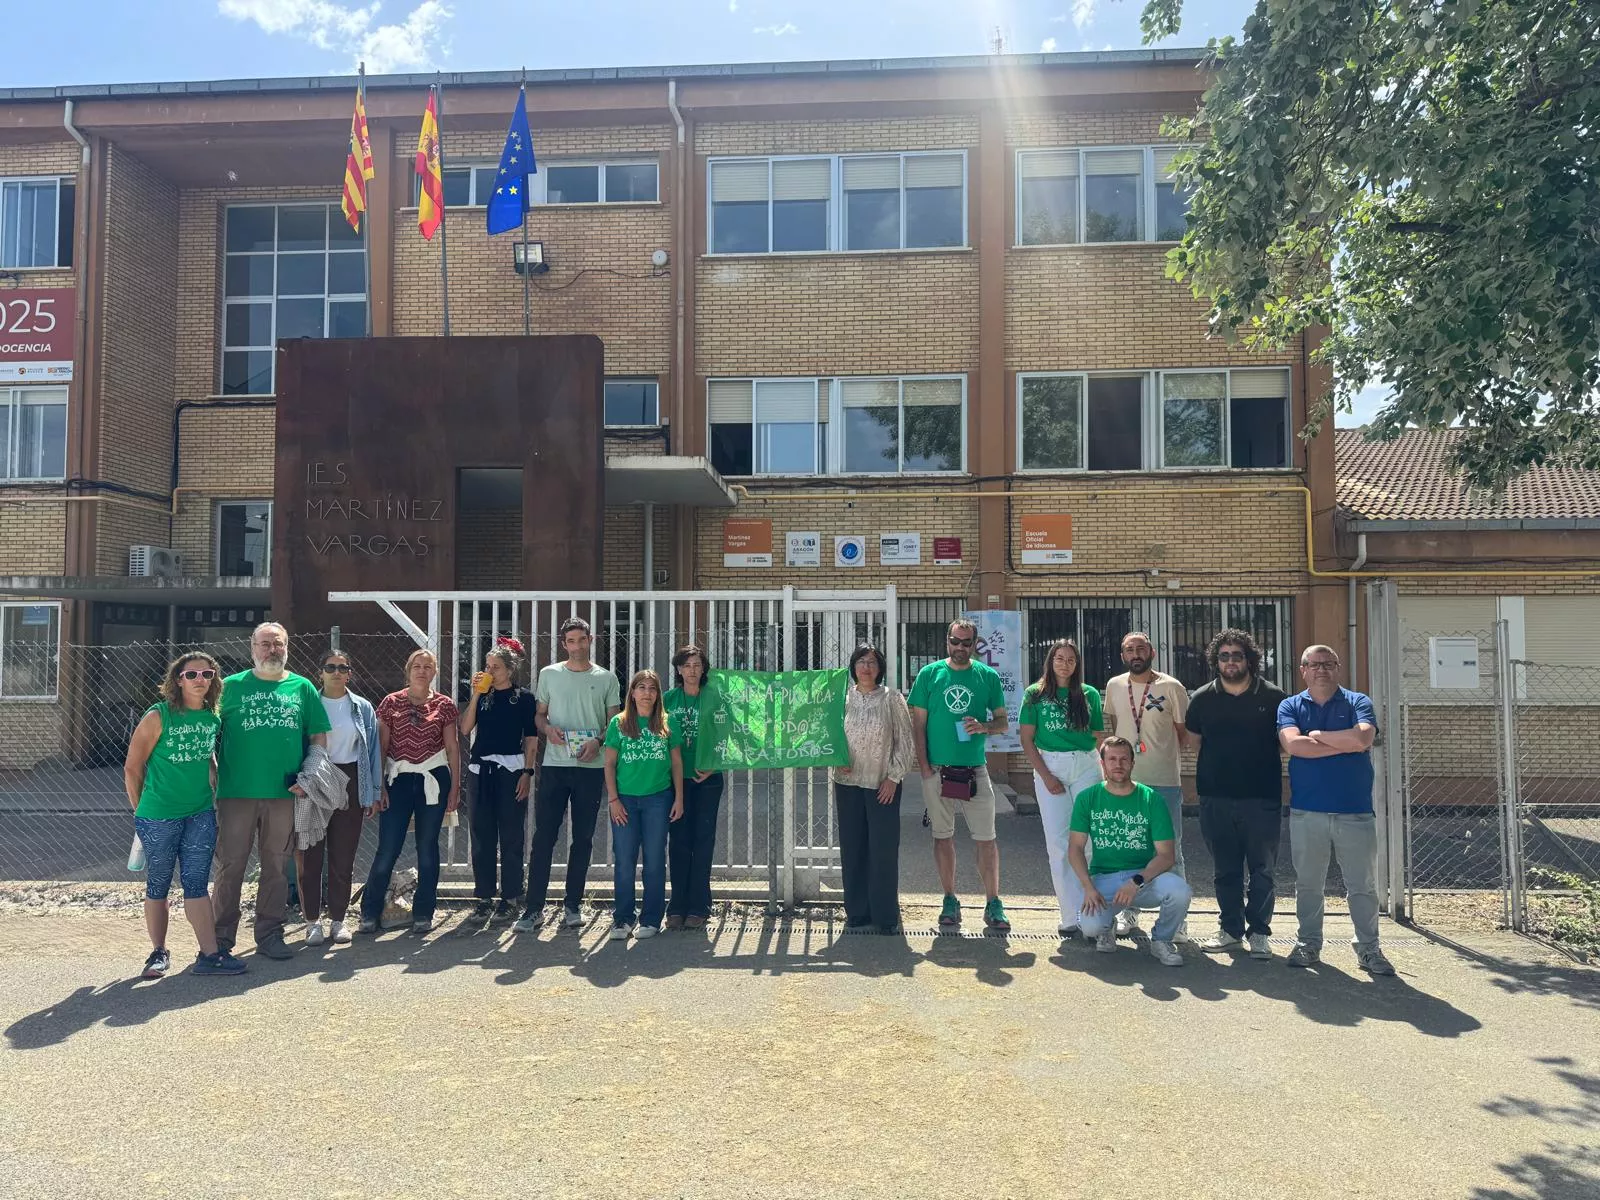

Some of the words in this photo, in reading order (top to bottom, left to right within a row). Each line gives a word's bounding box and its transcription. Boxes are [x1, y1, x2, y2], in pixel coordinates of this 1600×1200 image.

[0, 343, 52, 353] OCENCIA
[306, 534, 430, 556] VARGAS
[241, 691, 274, 703] ESCUELA
[249, 707, 263, 715] DE
[169, 723, 201, 736] ESCUELA
[244, 719, 270, 730] PARA
[732, 721, 751, 736] DE
[178, 743, 191, 751] DE
[626, 742, 637, 750] DE
[1091, 810, 1120, 820] ESCUELA
[1095, 840, 1117, 848] PARA
